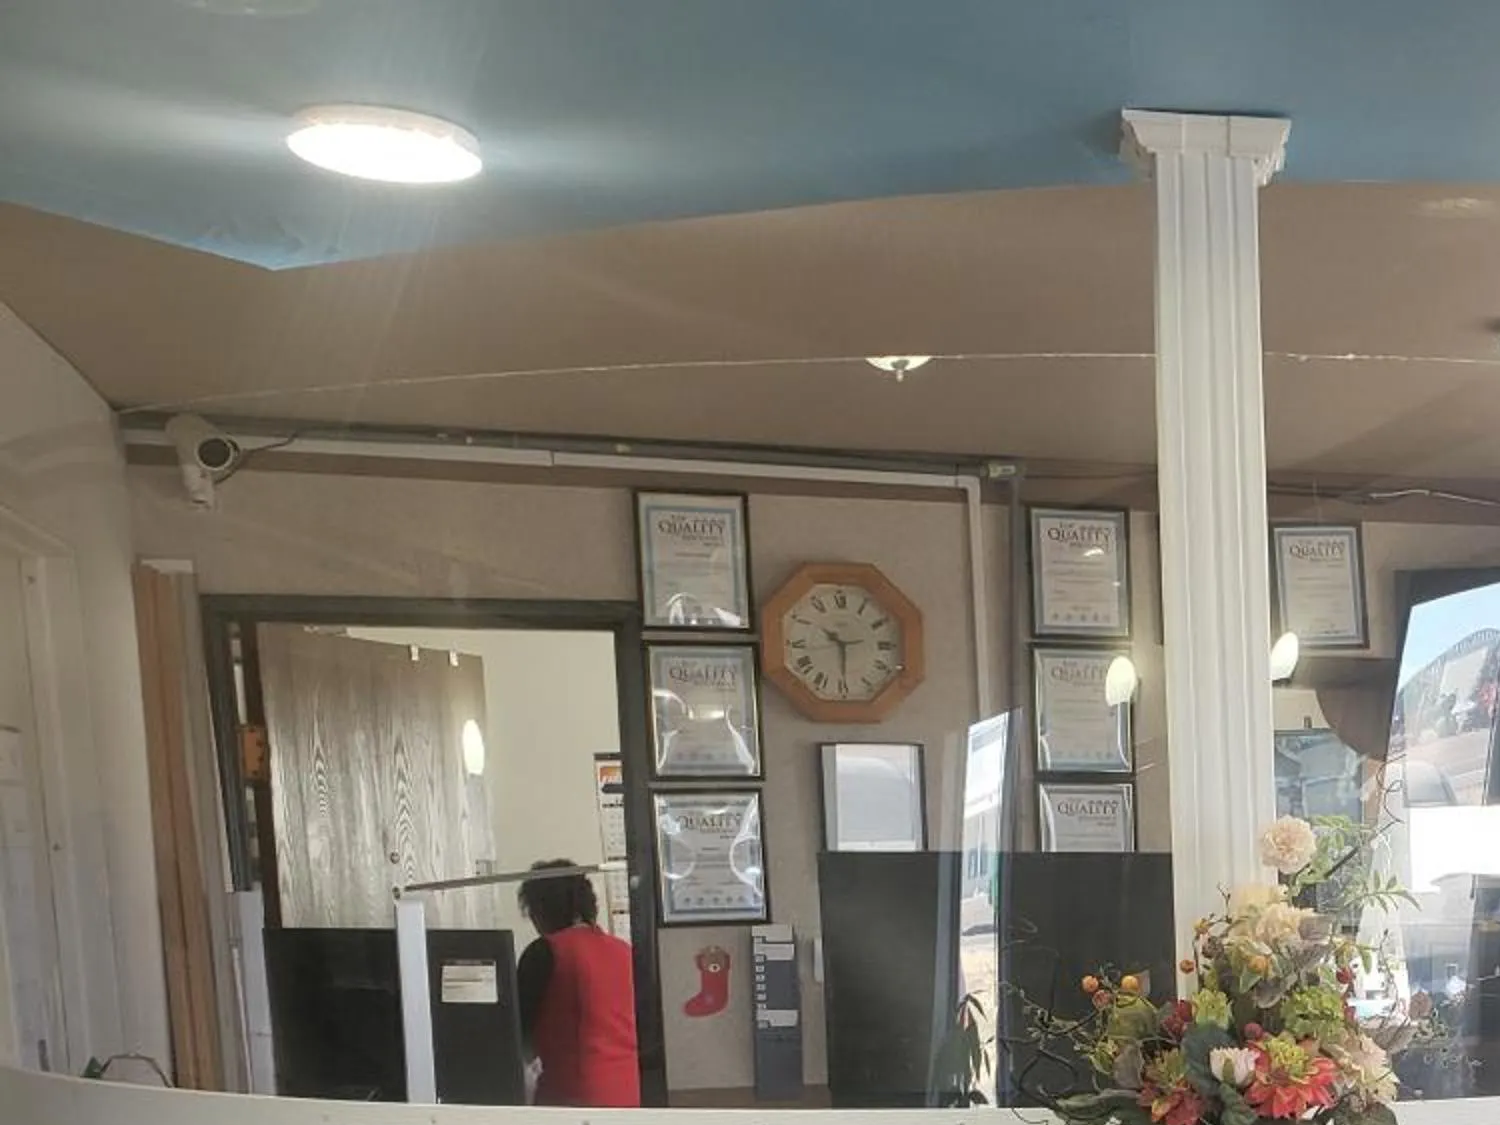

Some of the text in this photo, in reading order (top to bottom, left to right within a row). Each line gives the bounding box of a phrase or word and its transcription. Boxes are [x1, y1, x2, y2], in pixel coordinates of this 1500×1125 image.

[658, 519, 726, 535] QUALITY
[1047, 527, 1113, 542] QUALITY
[1289, 542, 1345, 558] QUALITY
[1058, 800, 1119, 816] QUALITY
